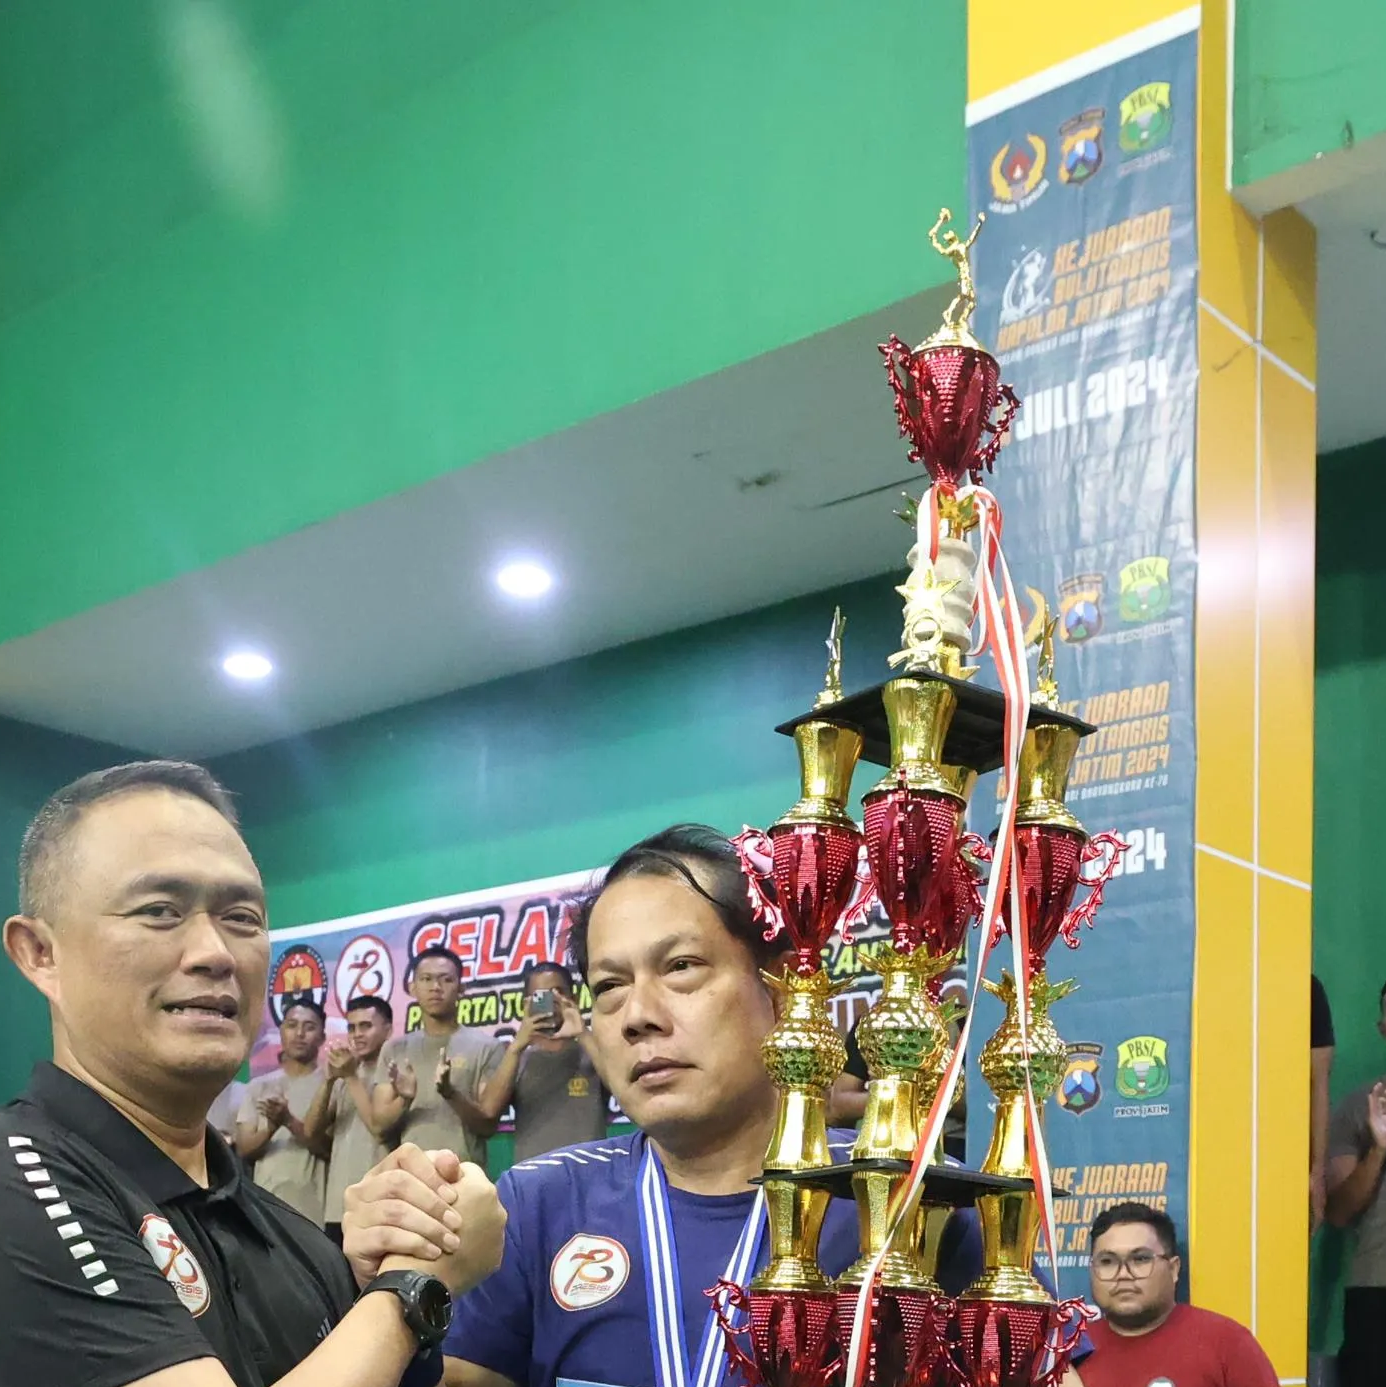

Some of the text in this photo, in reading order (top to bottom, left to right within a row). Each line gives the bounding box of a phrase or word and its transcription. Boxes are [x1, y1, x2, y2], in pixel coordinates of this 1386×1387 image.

[1016, 356, 1168, 442] JULI 2024
[1126, 744, 1170, 776] 2024
[1127, 1039, 1157, 1059] PBSI
